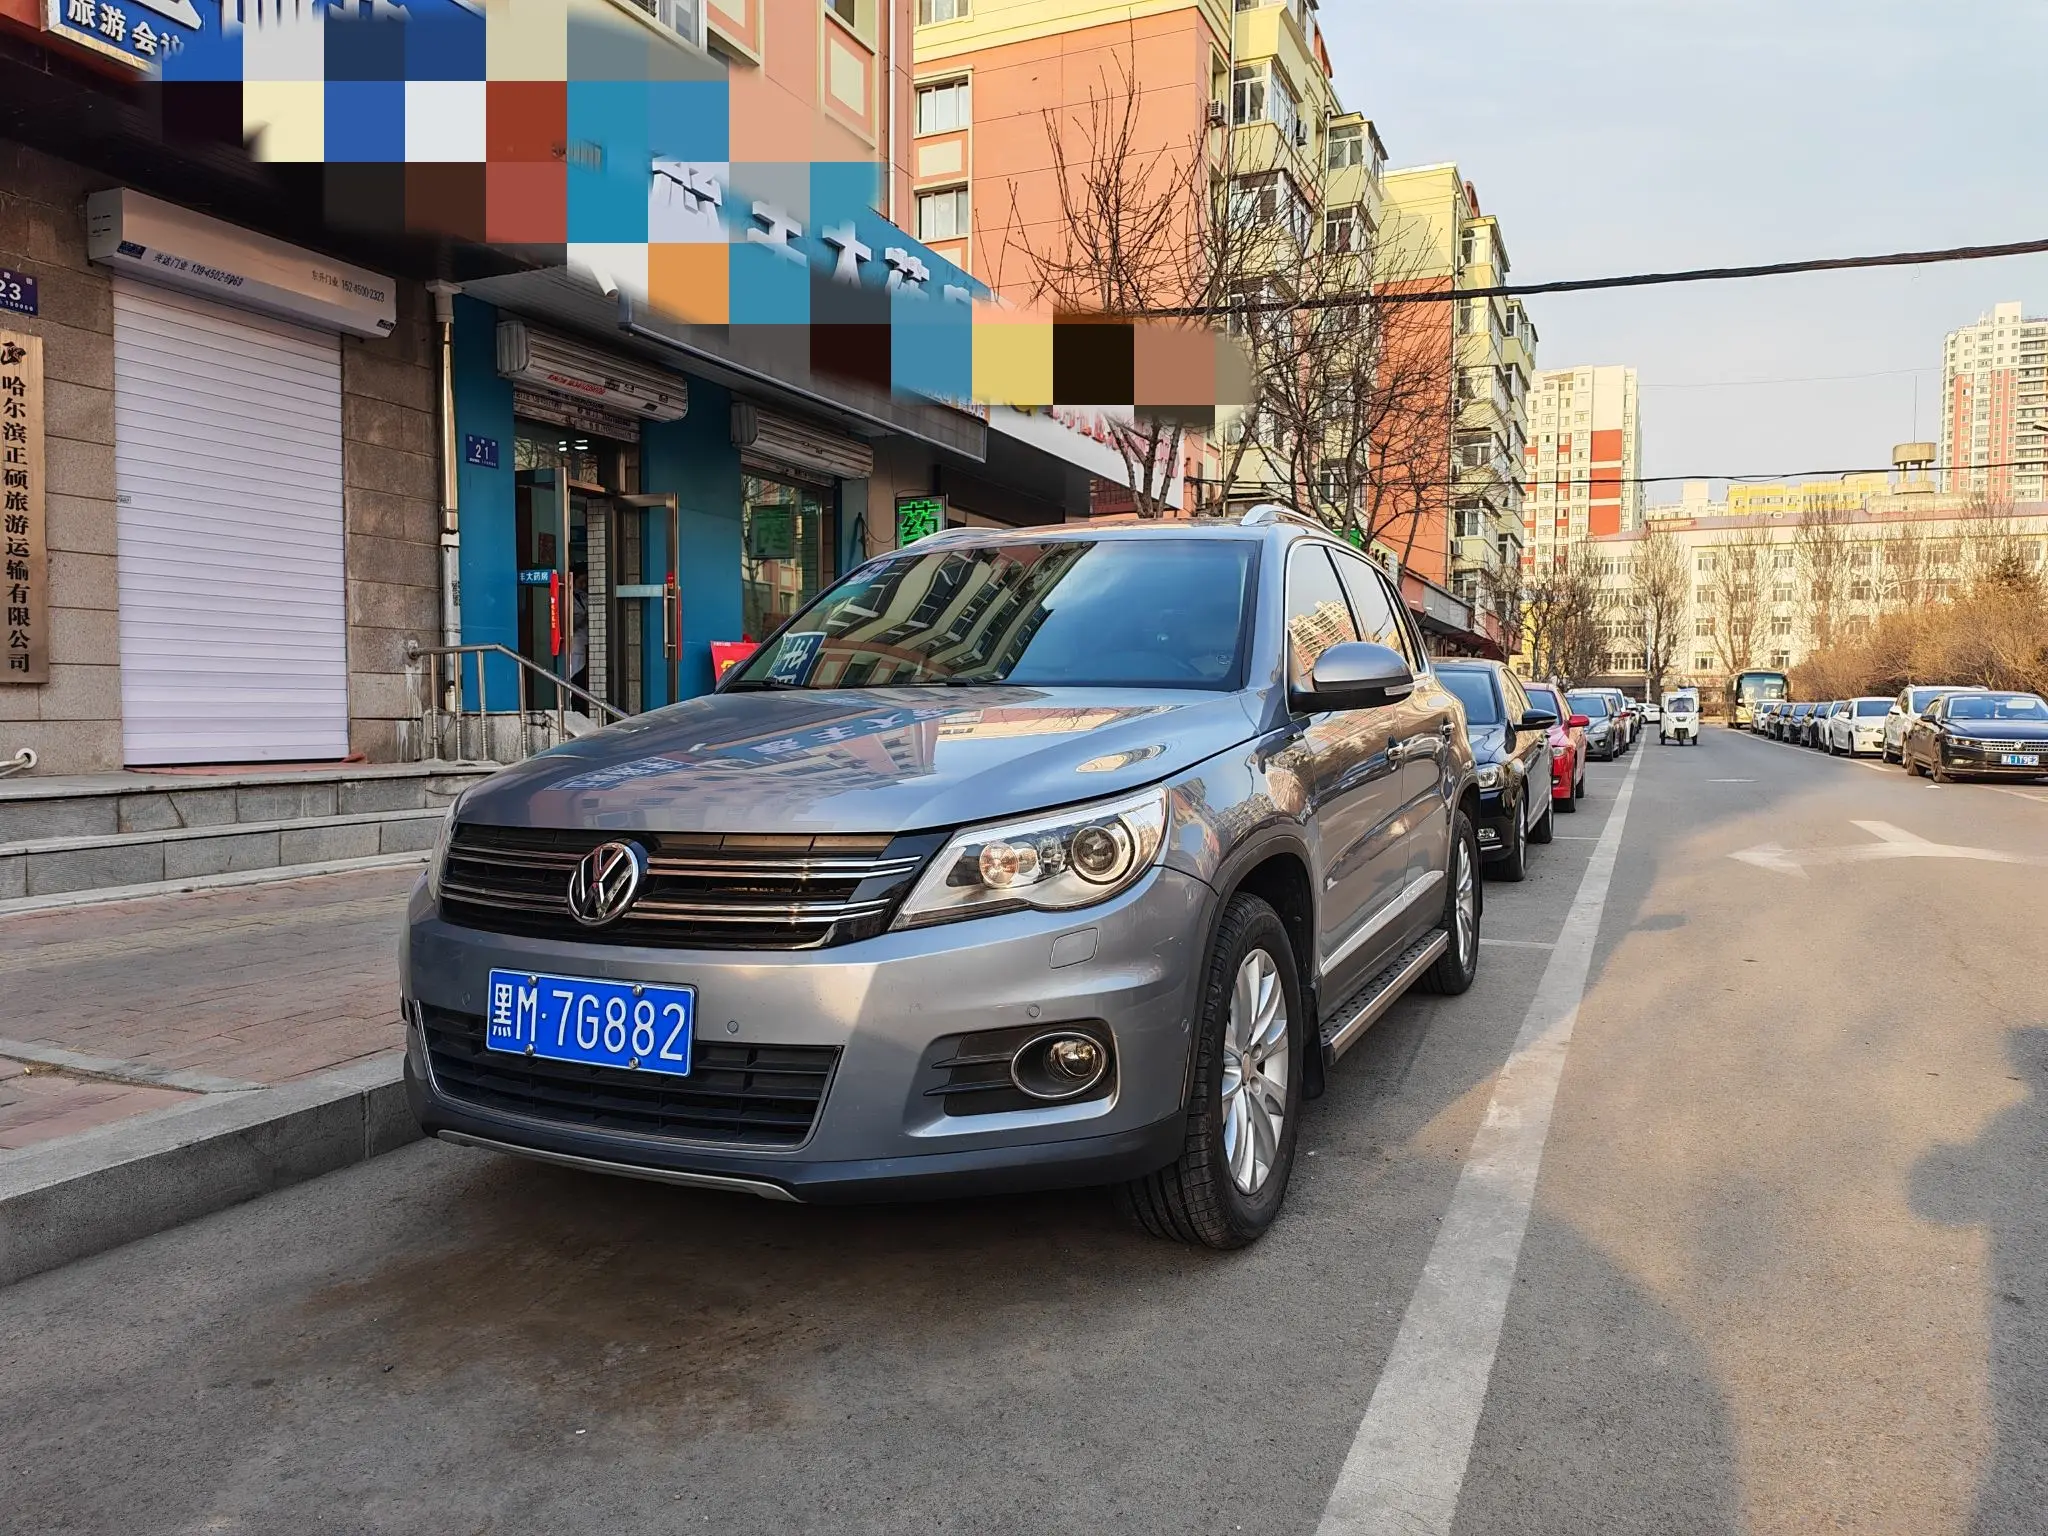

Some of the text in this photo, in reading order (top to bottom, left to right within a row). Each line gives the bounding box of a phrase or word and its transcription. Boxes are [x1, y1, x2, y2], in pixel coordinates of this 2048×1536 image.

[475, 444, 489, 460] 21
[2, 375, 31, 673] 哈尔滨正硕旅游运输有限公司
[899, 500, 942, 546] 药
